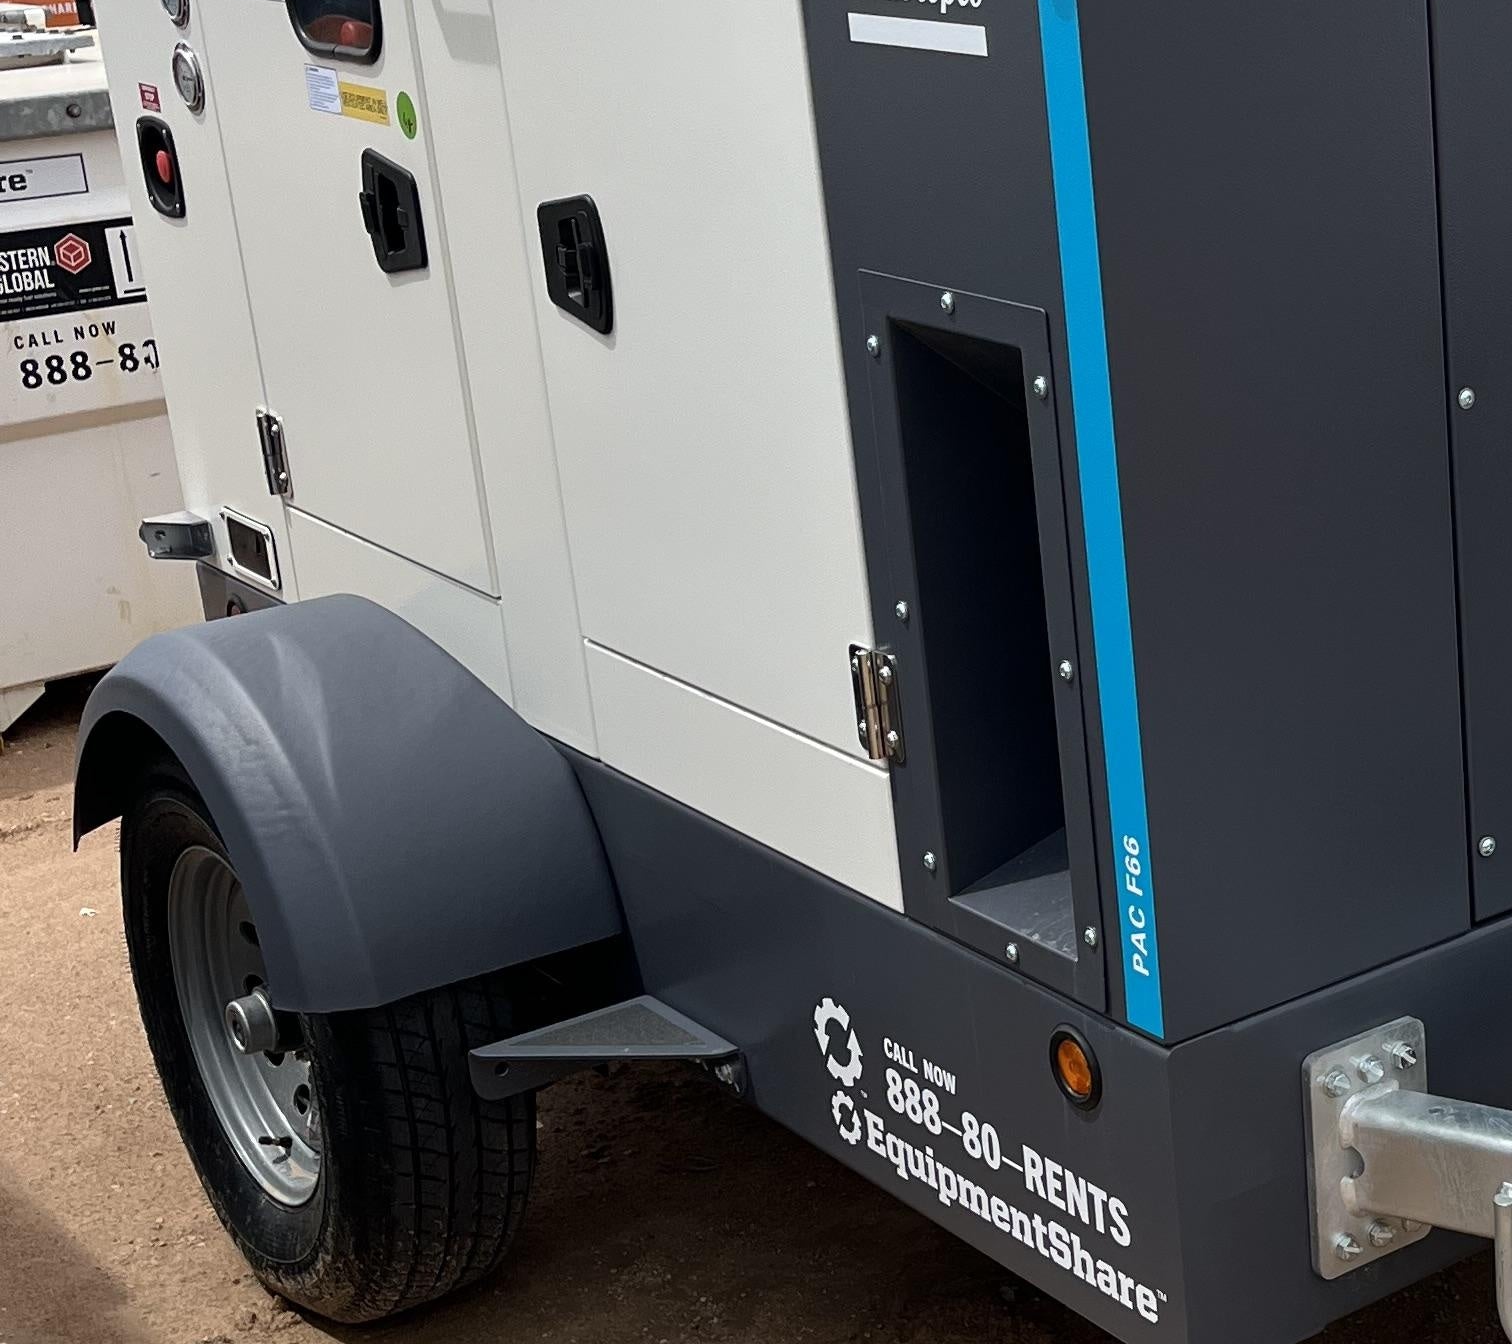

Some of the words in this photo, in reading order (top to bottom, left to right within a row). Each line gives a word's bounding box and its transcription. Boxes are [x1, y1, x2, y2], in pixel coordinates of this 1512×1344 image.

[14, 330, 63, 349] CALL
[74, 321, 115, 340] NOW
[1124, 835, 1143, 896] F66
[1128, 905, 1149, 976] PAC
[884, 1038, 918, 1073] CALL
[922, 1058, 956, 1094] NOW
